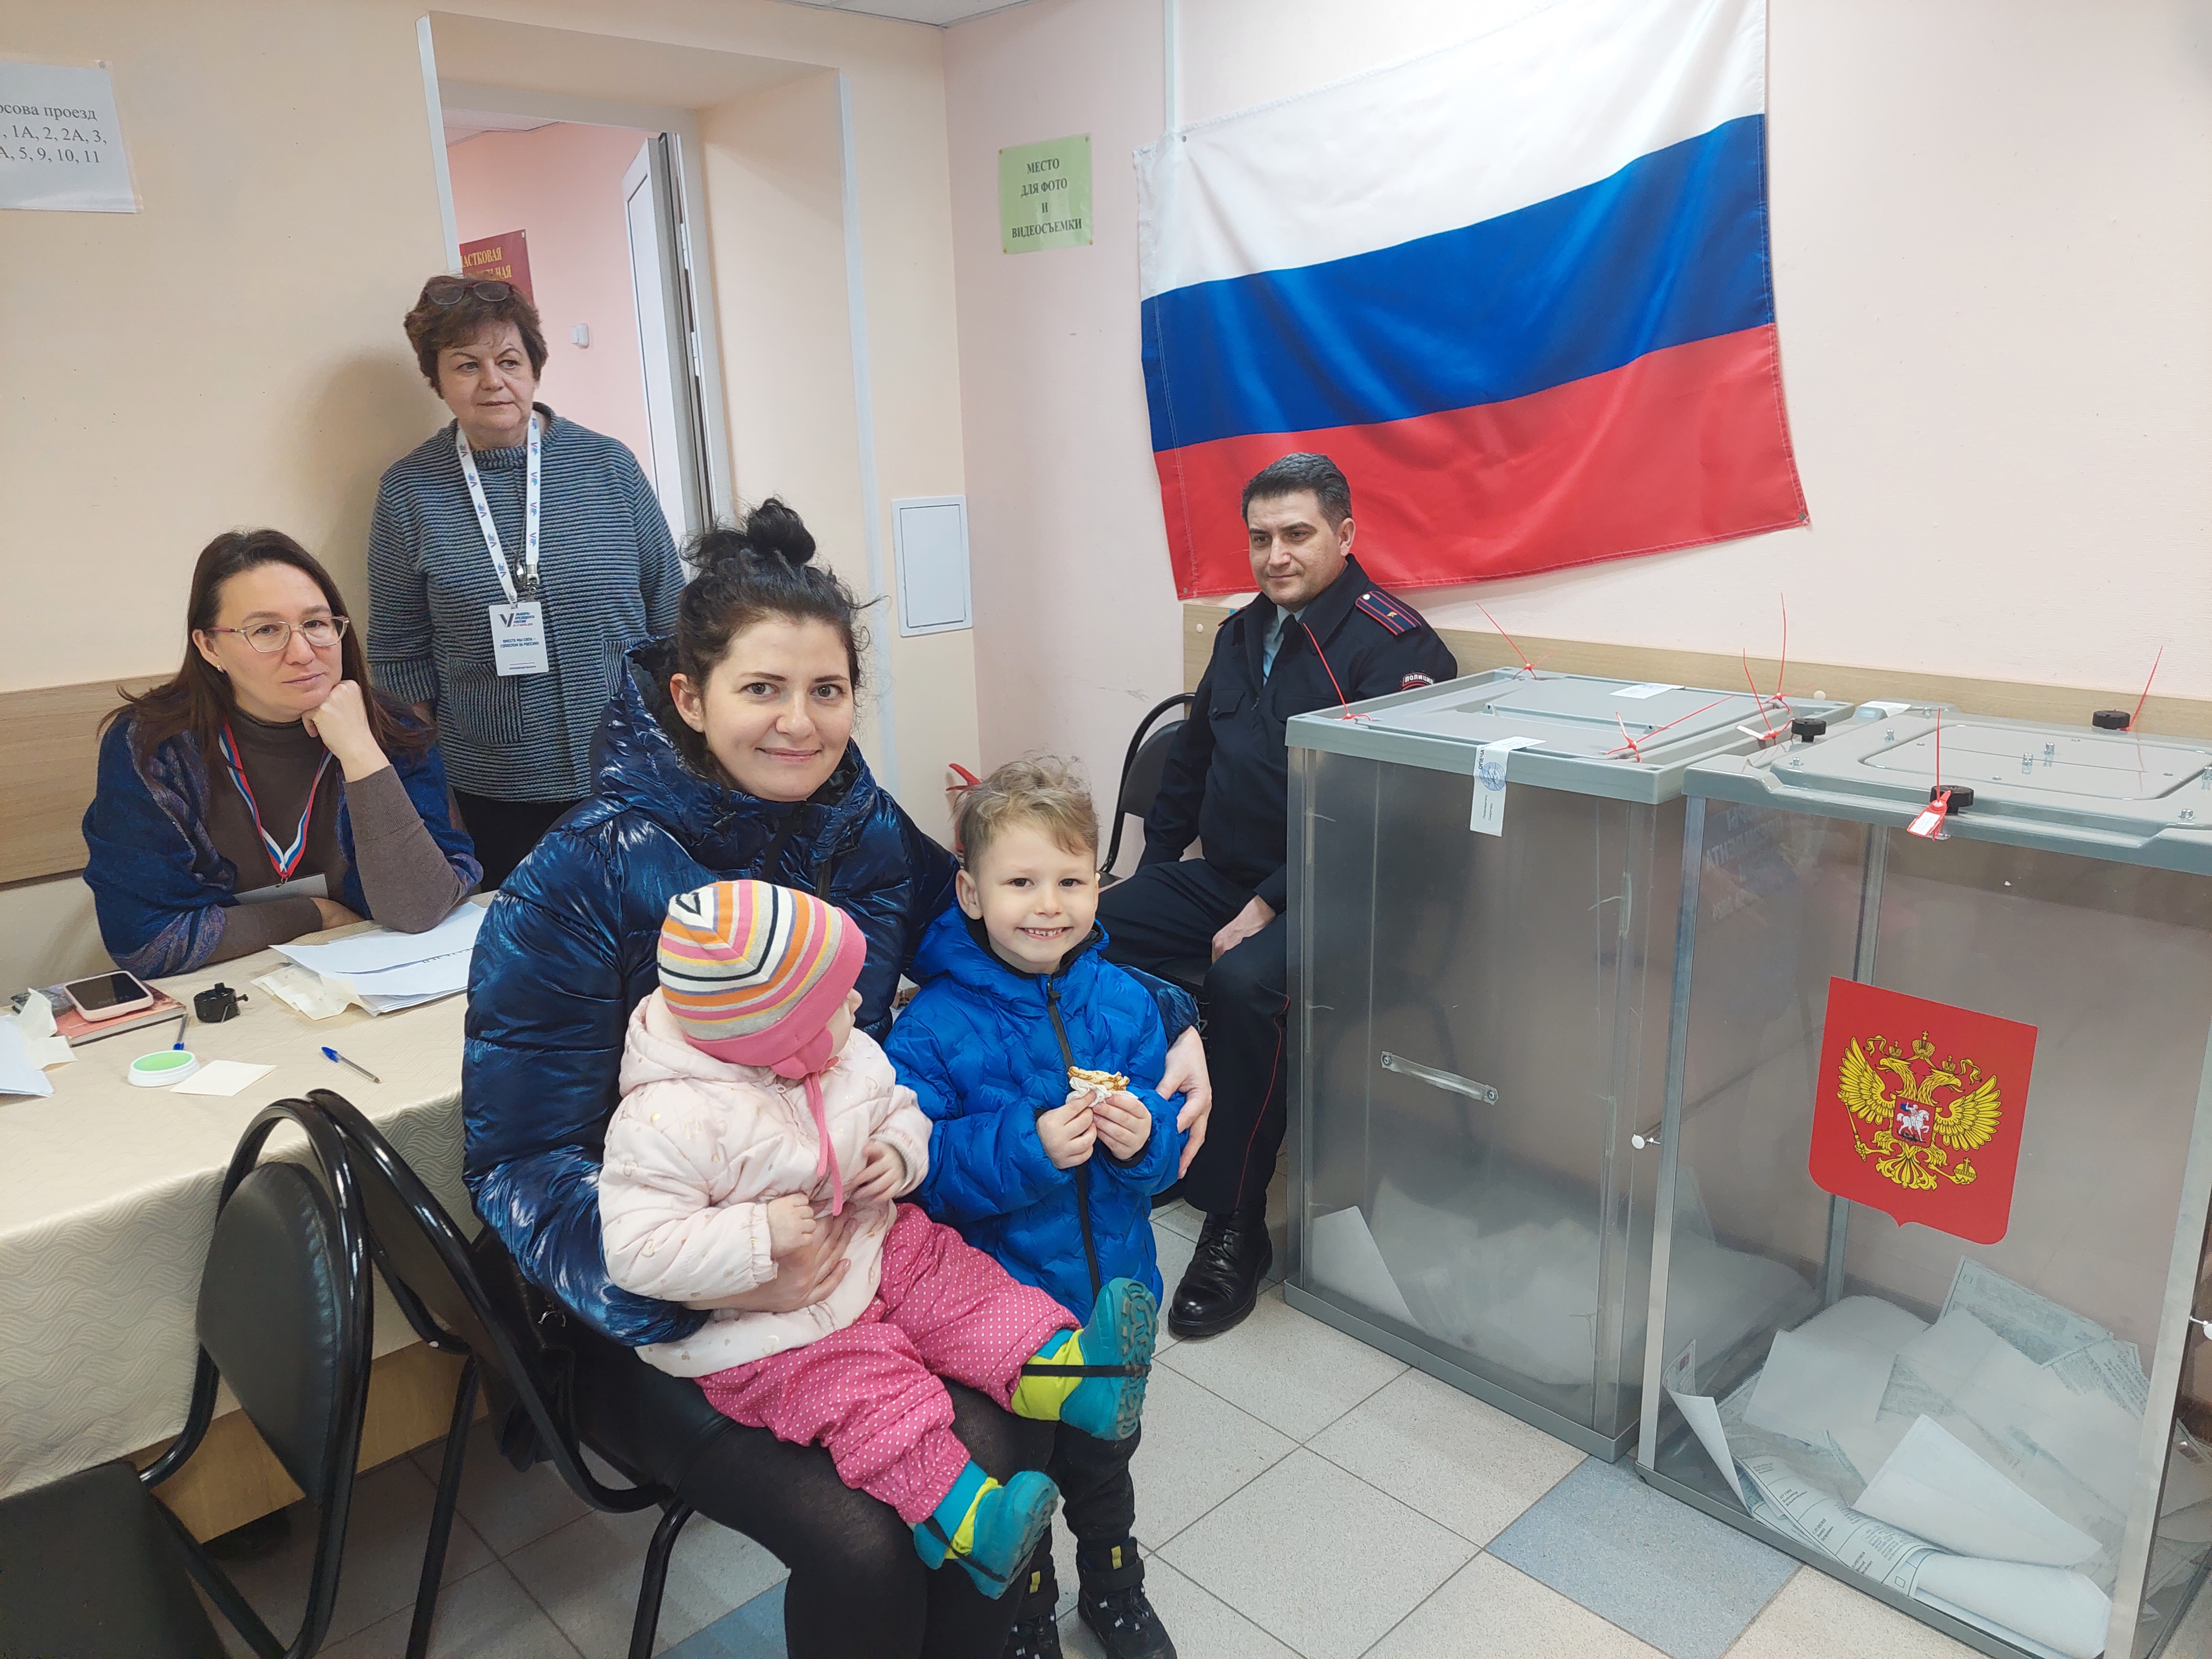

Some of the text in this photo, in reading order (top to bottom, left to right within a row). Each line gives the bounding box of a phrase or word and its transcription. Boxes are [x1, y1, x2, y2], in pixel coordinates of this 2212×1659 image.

[43, 106, 98, 121] проезд
[43, 126, 58, 142] 2,
[92, 129, 108, 145] 3,
[19, 147, 33, 161] 5,
[36, 147, 52, 163] 9,
[57, 148, 79, 164] 10,
[84, 150, 100, 163] 11
[1027, 158, 1060, 174] МЕСТО
[1020, 177, 1068, 197] ДЛЯ ФОТО
[1041, 202, 1049, 213] И
[1011, 218, 1082, 238] ВИДЕОСЪЕМКИ
[1405, 674, 1434, 685] ПОЛИЦИЯ
